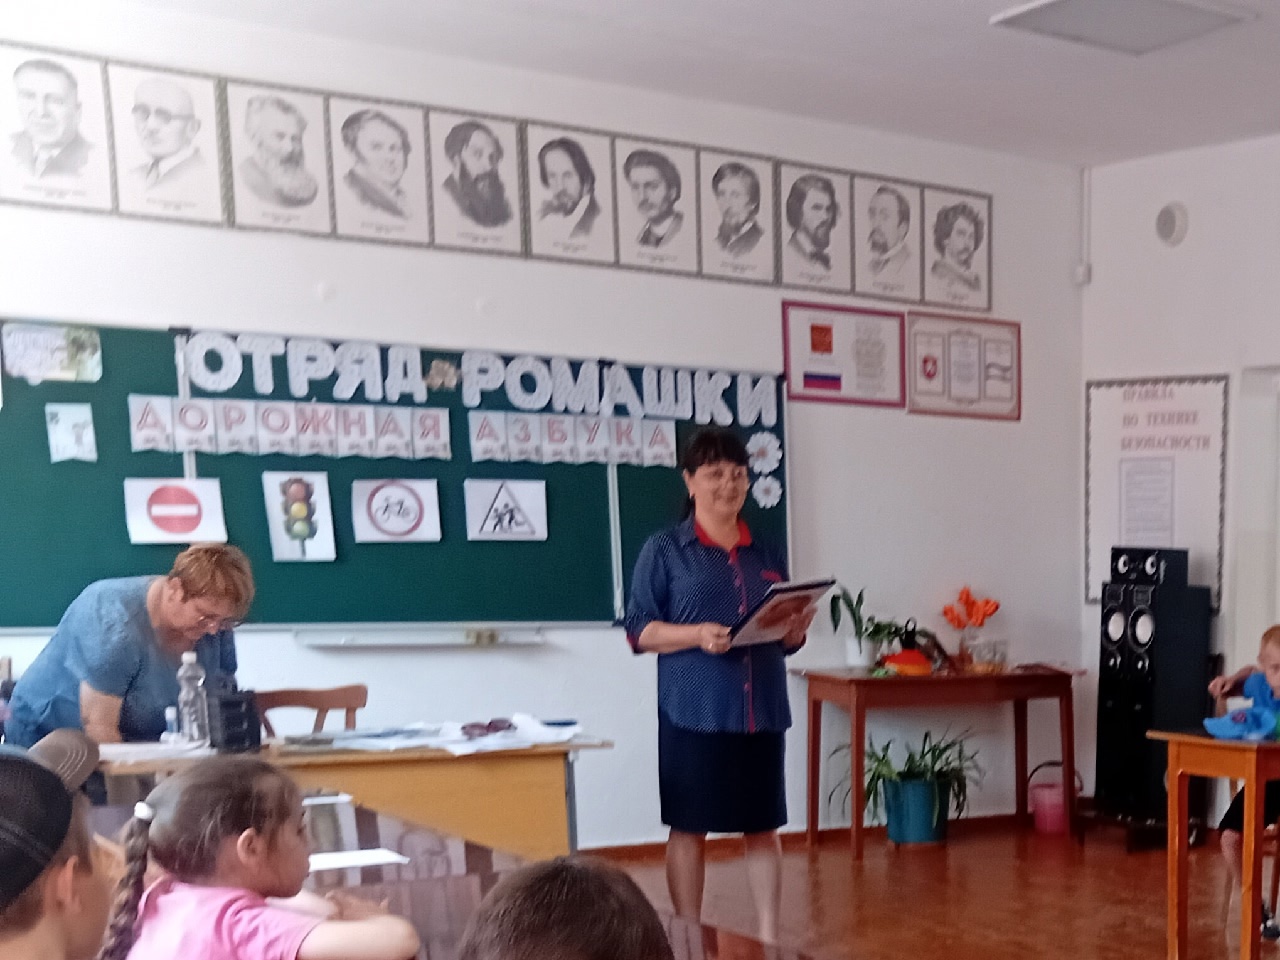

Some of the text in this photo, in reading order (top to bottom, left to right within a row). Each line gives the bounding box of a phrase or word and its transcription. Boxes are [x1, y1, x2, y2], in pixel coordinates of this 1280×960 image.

[186, 331, 428, 403] ОТРЯД
[462, 351, 777, 427] РОМАШКИ
[136, 402, 669, 449] ДОРОЖНАЯ АЗБУКА
[1148, 411, 1199, 426] ТЕХНИКЕ
[1120, 436, 1211, 451] БЕЗОПАСНОСТИ
